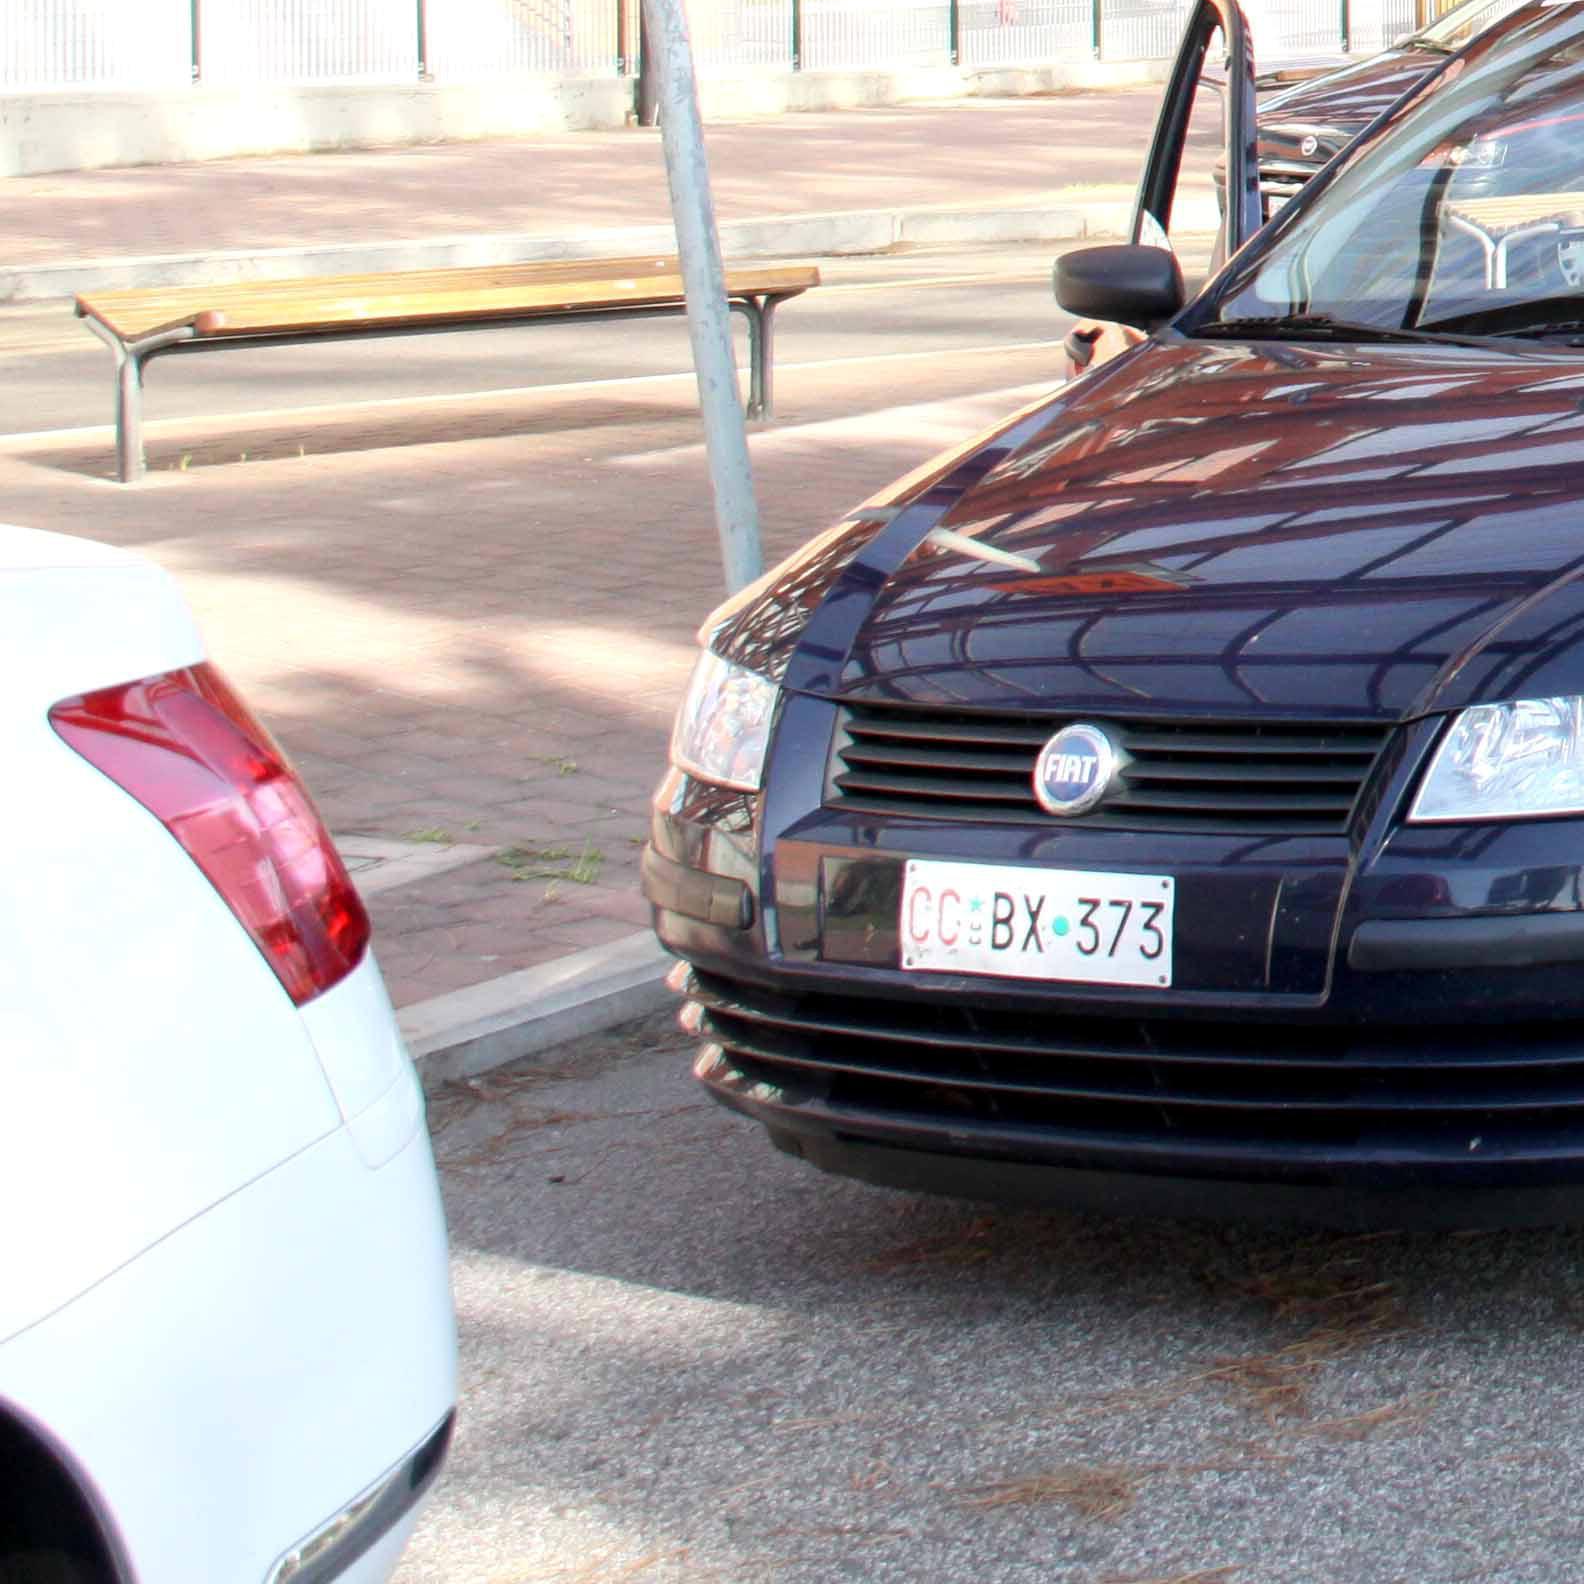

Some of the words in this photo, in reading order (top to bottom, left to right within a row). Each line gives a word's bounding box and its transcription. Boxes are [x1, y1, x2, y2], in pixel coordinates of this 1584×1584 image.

[1044, 752, 1097, 784] FIAT
[908, 885, 961, 946] CC
[990, 891, 1046, 953] BX
[1075, 897, 1165, 960] 373
